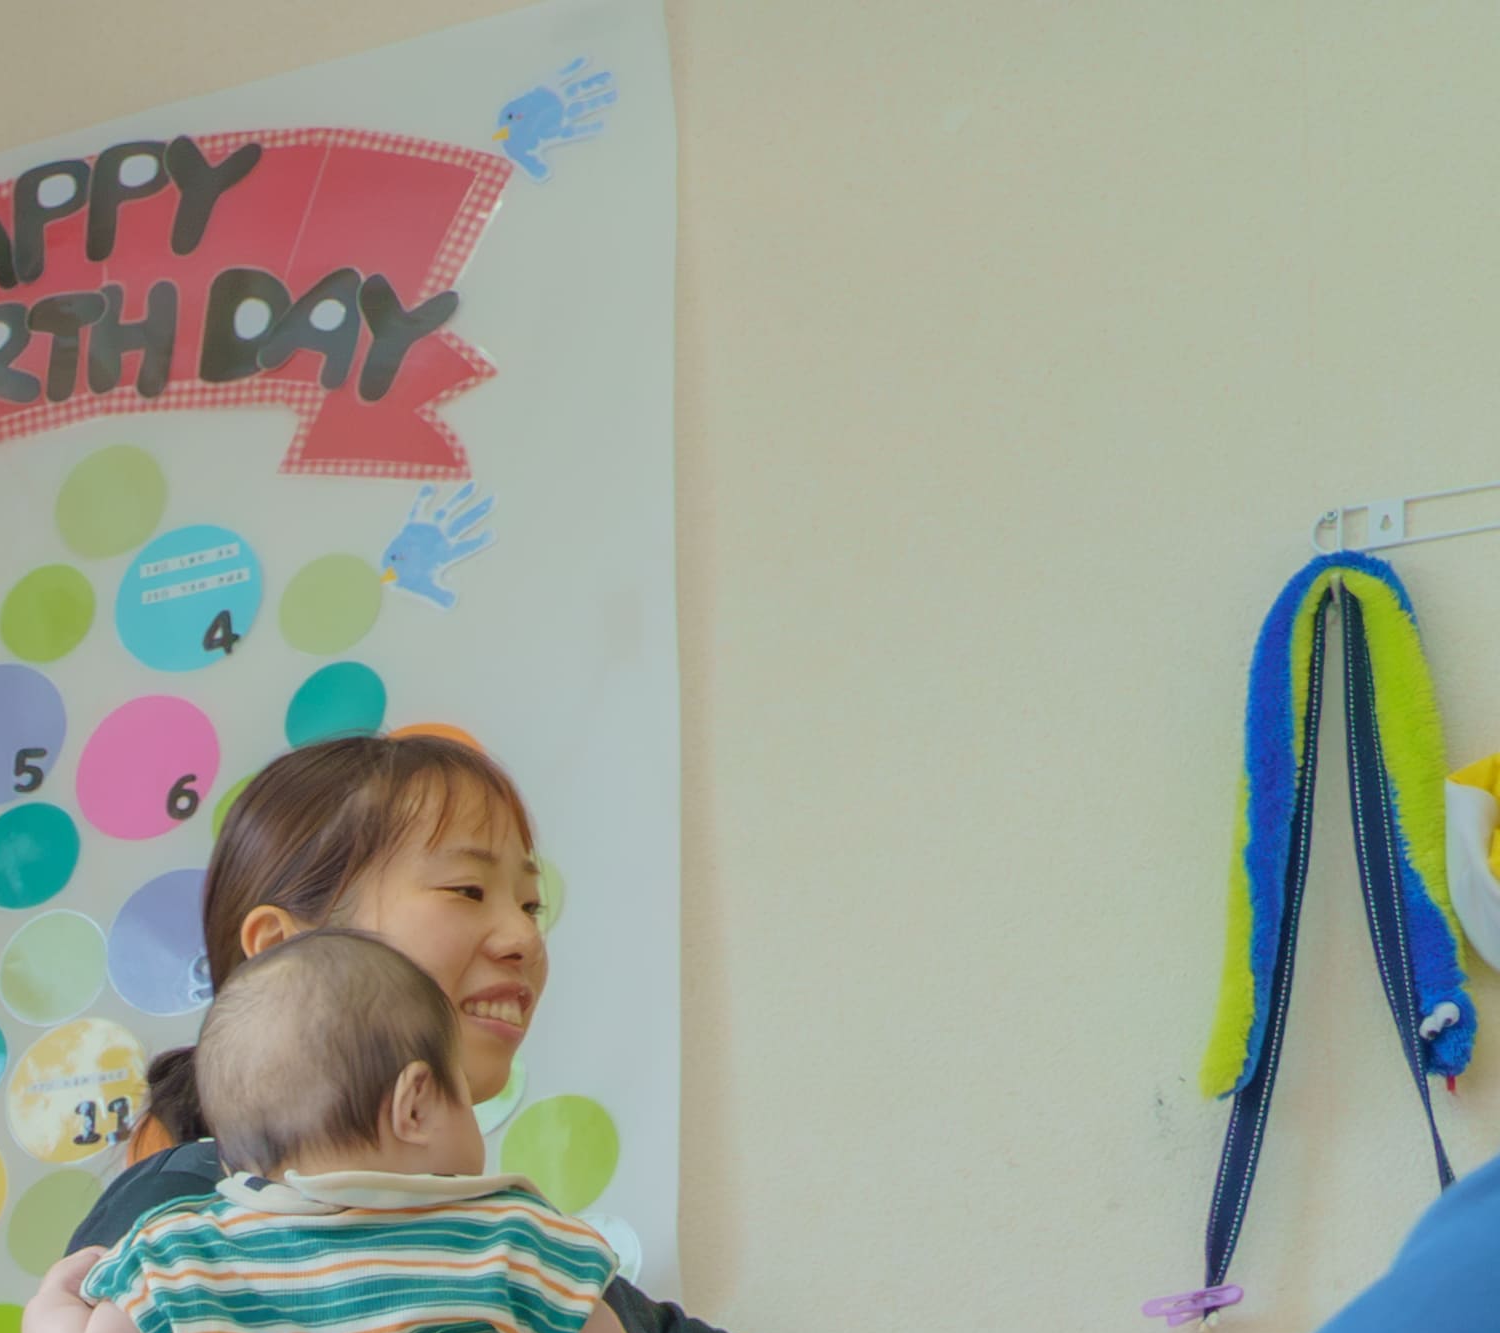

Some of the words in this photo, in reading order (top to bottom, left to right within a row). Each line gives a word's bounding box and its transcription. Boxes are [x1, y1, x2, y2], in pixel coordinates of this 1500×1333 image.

[200, 267, 460, 402] DAY
[202, 609, 240, 655] 4
[13, 747, 47, 793] 5
[166, 773, 200, 821] 6
[73, 1097, 137, 1146] 11
